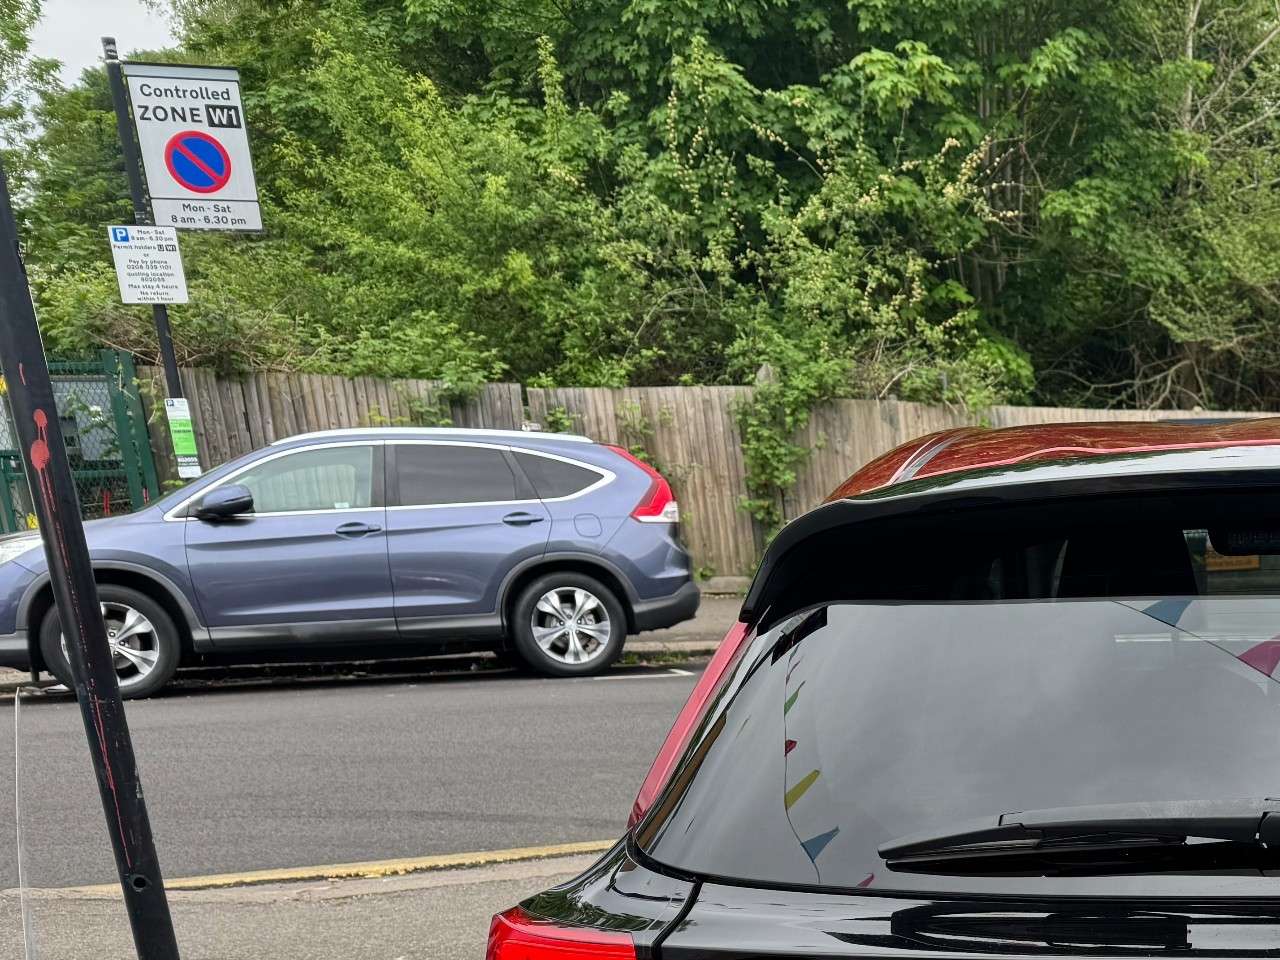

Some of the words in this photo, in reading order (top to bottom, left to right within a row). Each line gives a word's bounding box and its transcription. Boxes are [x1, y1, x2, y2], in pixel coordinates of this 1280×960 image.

[140, 83, 231, 101] Controlled
[137, 104, 203, 123] ZONE
[207, 106, 239, 126] W1
[182, 203, 205, 212] Mon
[213, 204, 231, 213] Sat
[171, 214, 177, 223] 8
[180, 216, 196, 224] am
[203, 215, 228, 224] 6.30
[231, 218, 247, 226] pm
[116, 229, 126, 240] P
